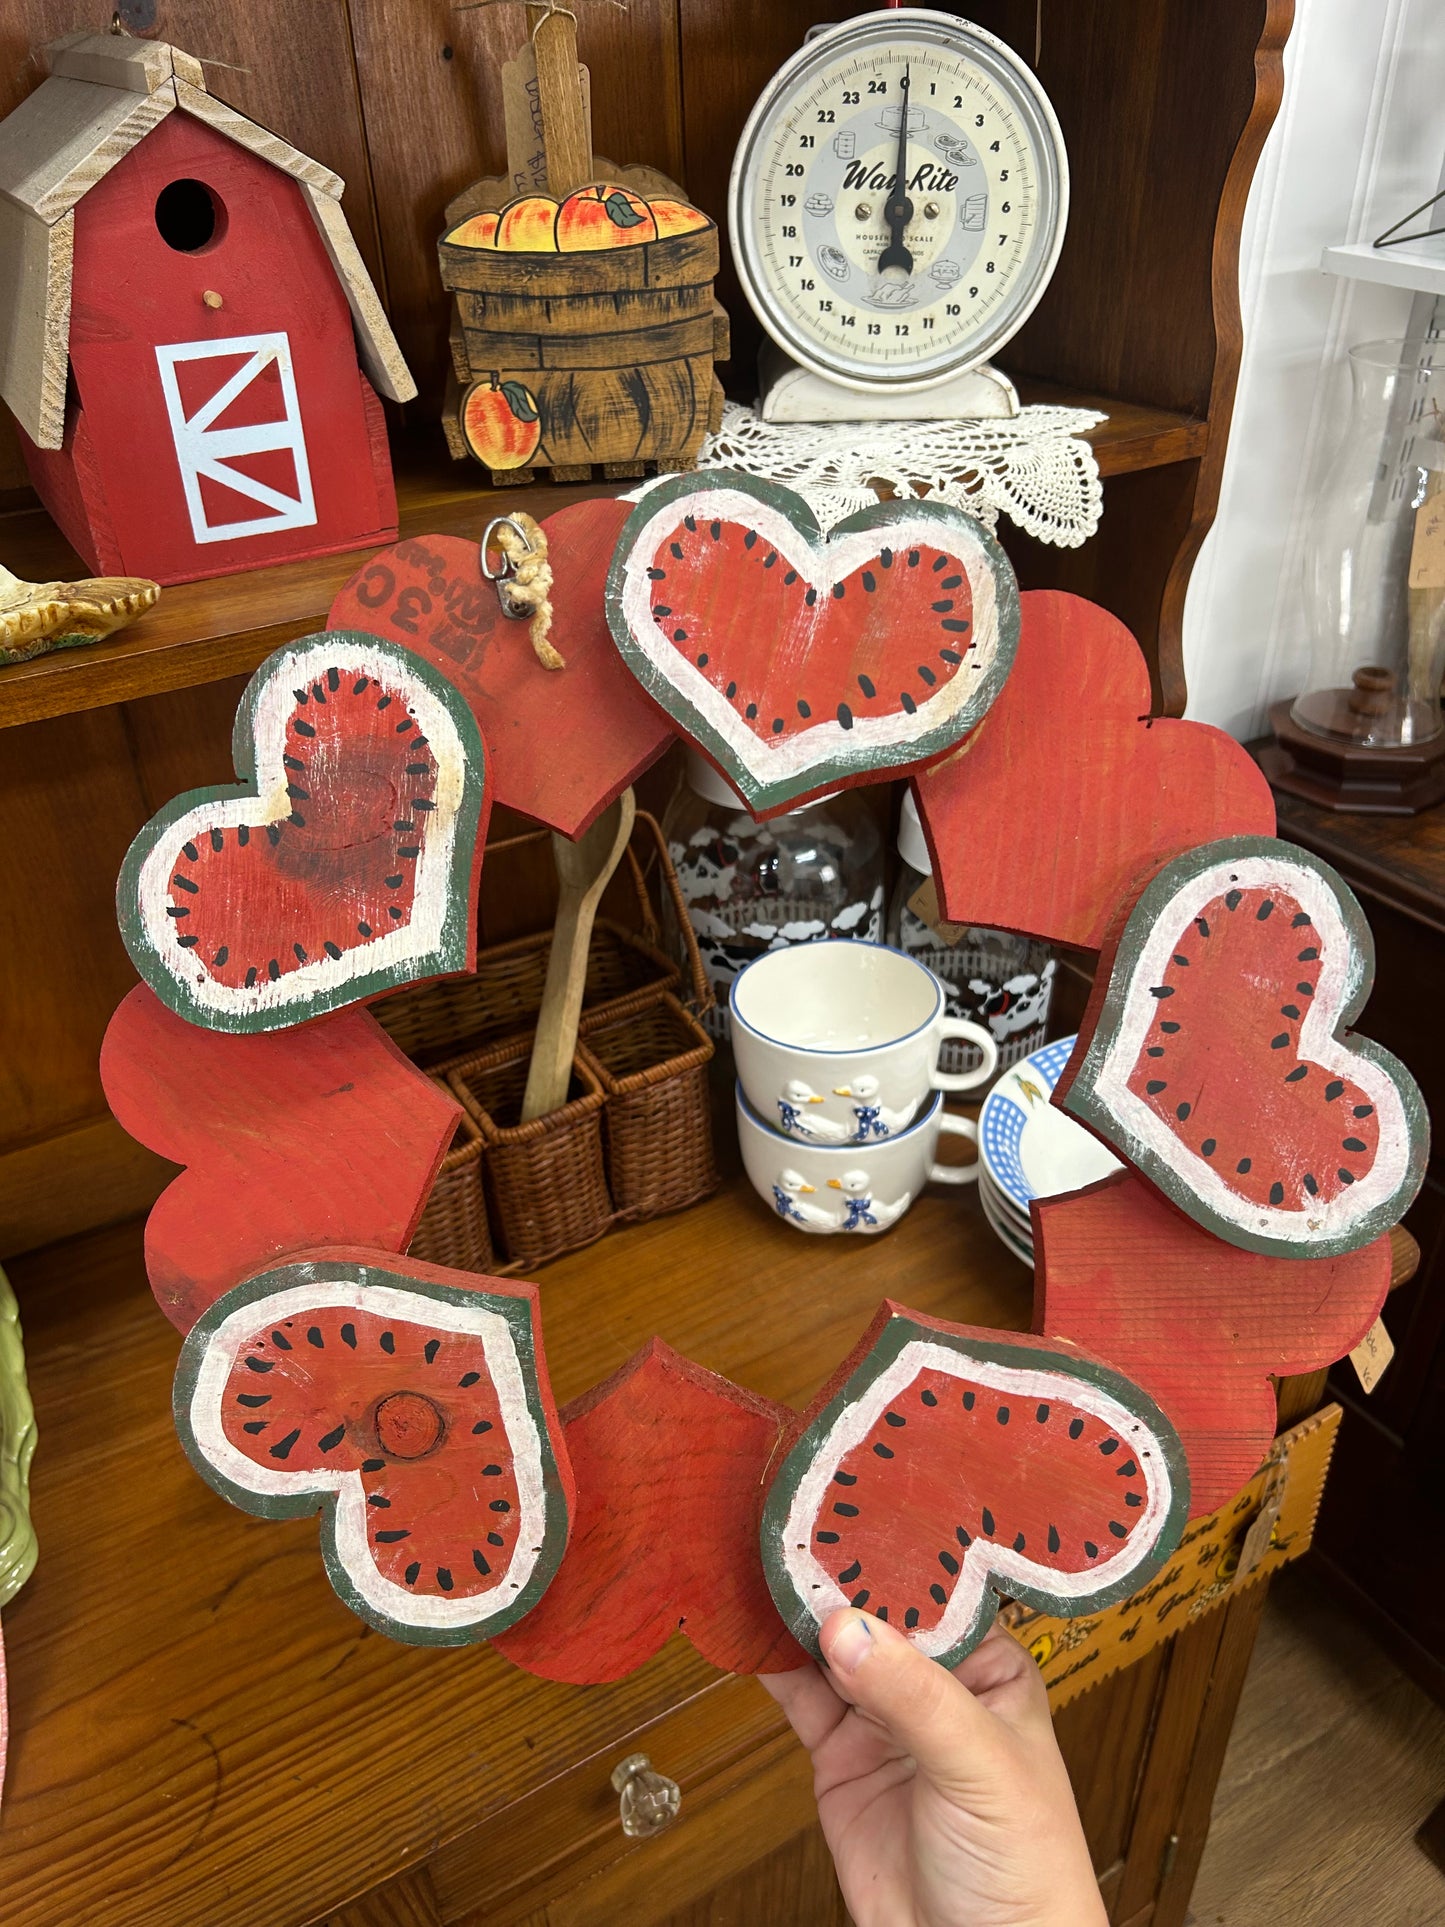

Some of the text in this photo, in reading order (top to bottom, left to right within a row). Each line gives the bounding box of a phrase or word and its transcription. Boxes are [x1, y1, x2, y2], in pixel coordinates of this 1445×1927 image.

[868, 81, 886, 94] 24
[900, 76, 911, 91] 0
[930, 83, 936, 95] 1
[843, 92, 859, 104] 23
[954, 96, 962, 108] 2
[818, 110, 834, 122] 22
[976, 115, 984, 126] 3
[800, 135, 814, 147] 21
[990, 141, 999, 152] 4
[786, 164, 804, 176] 20
[1000, 170, 1008, 181] 5
[781, 195, 796, 206] 19
[1002, 202, 1010, 213] 6
[783, 226, 796, 237] 18
[855, 234, 934, 243] HOUSEHD SCALE
[998, 235, 1007, 245] 7
[790, 256, 802, 267] 17
[986, 262, 994, 273] 8
[802, 280, 814, 290] 16
[970, 287, 978, 297] 9
[820, 301, 832, 311] 15
[947, 305, 960, 315] 10
[841, 316, 855, 326] 14
[923, 318, 934, 328] 11
[867, 324, 880, 334] 13
[895, 325, 908, 335] 12
[1118, 1564, 1185, 1616] bright
[1119, 1616, 1143, 1643] of
